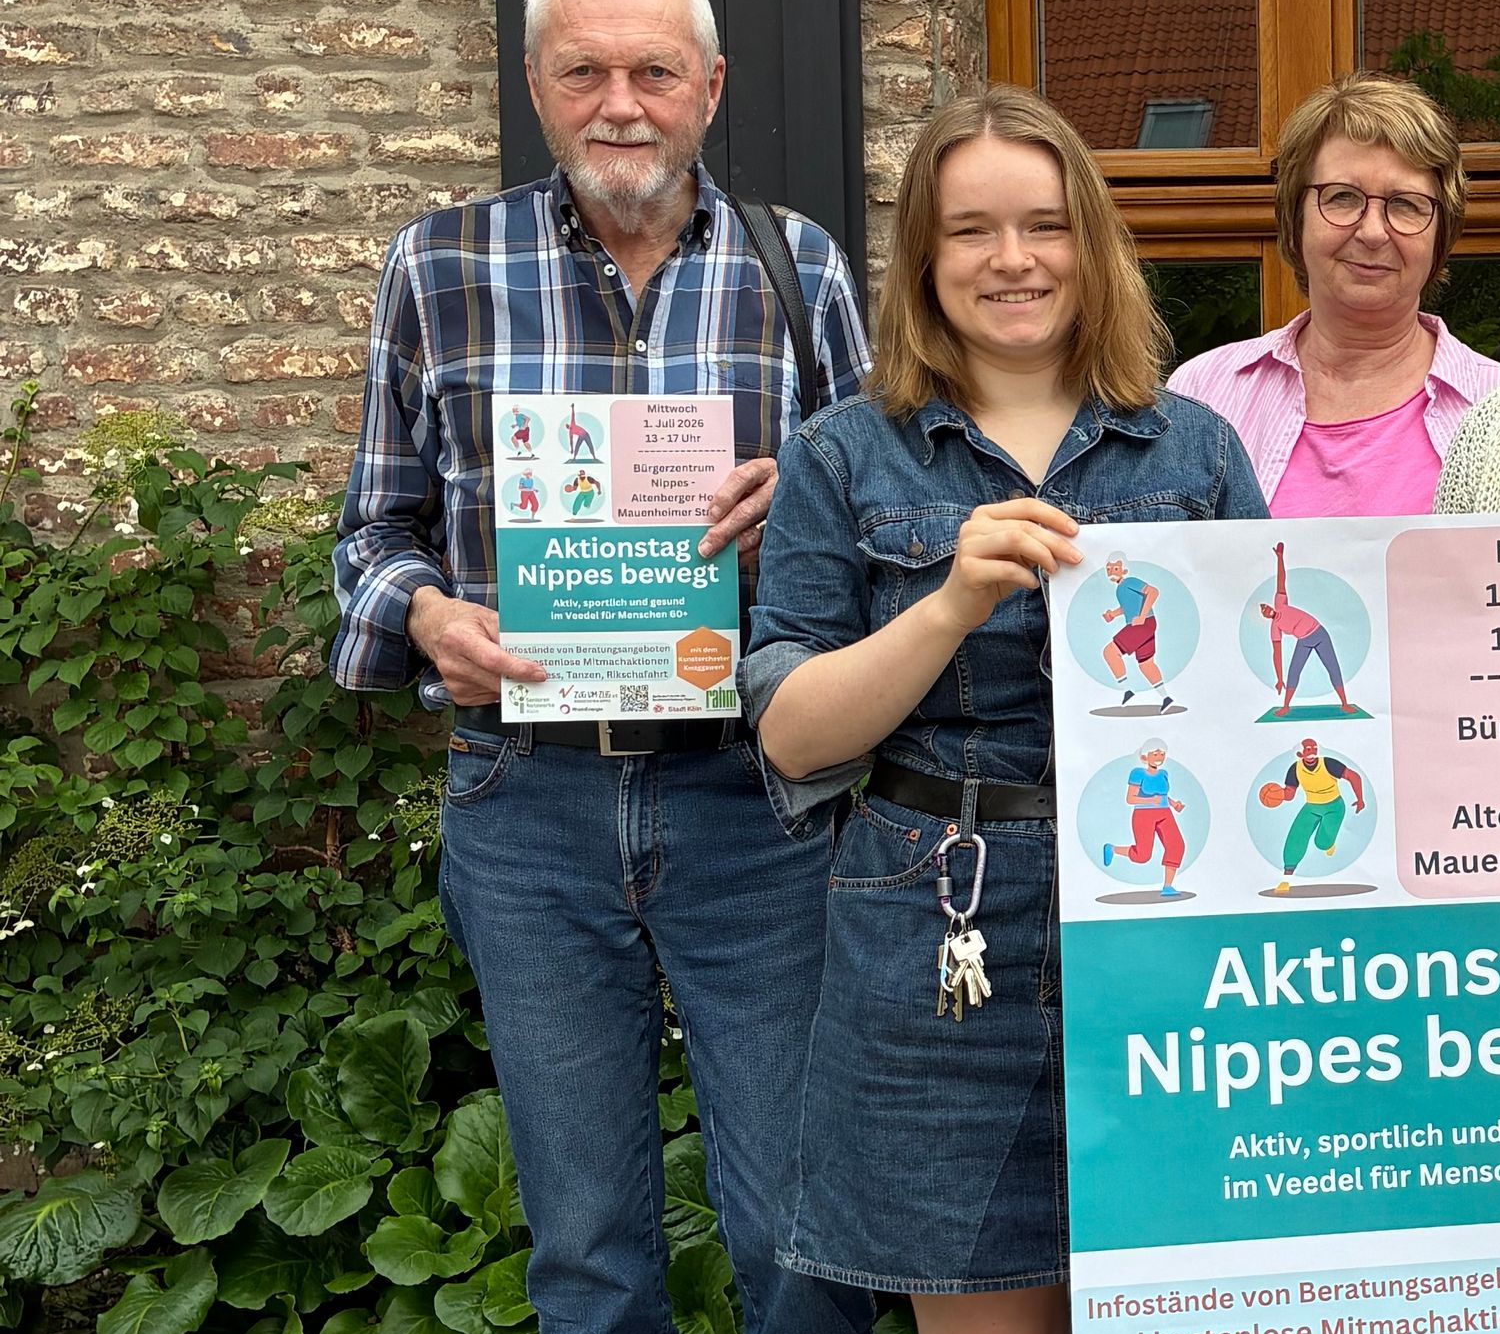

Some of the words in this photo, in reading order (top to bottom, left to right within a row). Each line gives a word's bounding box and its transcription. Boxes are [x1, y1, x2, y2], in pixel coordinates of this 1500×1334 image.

[647, 404, 697, 414] Mittwoch
[643, 419, 653, 428] 1.
[655, 419, 675, 428] Juli
[677, 419, 704, 428] 2026
[645, 434, 658, 443] 13
[667, 434, 679, 443] 17
[681, 434, 701, 443] Uhr
[633, 464, 714, 474] Bürgerzentrum
[651, 479, 688, 488] Nippes
[631, 494, 695, 504] Altenberger
[618, 509, 692, 517] Mauenheimer
[544, 537, 690, 561] Aktionstag
[517, 563, 613, 591] Nippes
[621, 563, 720, 588] bewegt
[553, 598, 581, 609] Aktiv,
[583, 598, 627, 609] sportlich
[630, 598, 648, 606] und
[651, 597, 685, 608] gesund
[565, 611, 599, 620] Veedel
[601, 610, 616, 620] für
[618, 610, 668, 619] Menschen
[670, 610, 688, 619] 60+
[576, 645, 670, 655] Beratungsangeboten
[584, 657, 669, 666] Mitmachaktionen
[566, 671, 604, 680] Tanzen,
[607, 670, 668, 679] Rikschafahrt
[706, 686, 736, 708] rahm
[1127, 1028, 1402, 1108] Nippes
[1229, 1132, 1311, 1162] Aktiv,
[1317, 1121, 1443, 1156] sportlich
[1223, 1175, 1257, 1201] im
[1264, 1167, 1364, 1197] Veedel
[1369, 1164, 1413, 1190] für
[1086, 1287, 1235, 1321] Infostände
[1242, 1285, 1292, 1307] von
